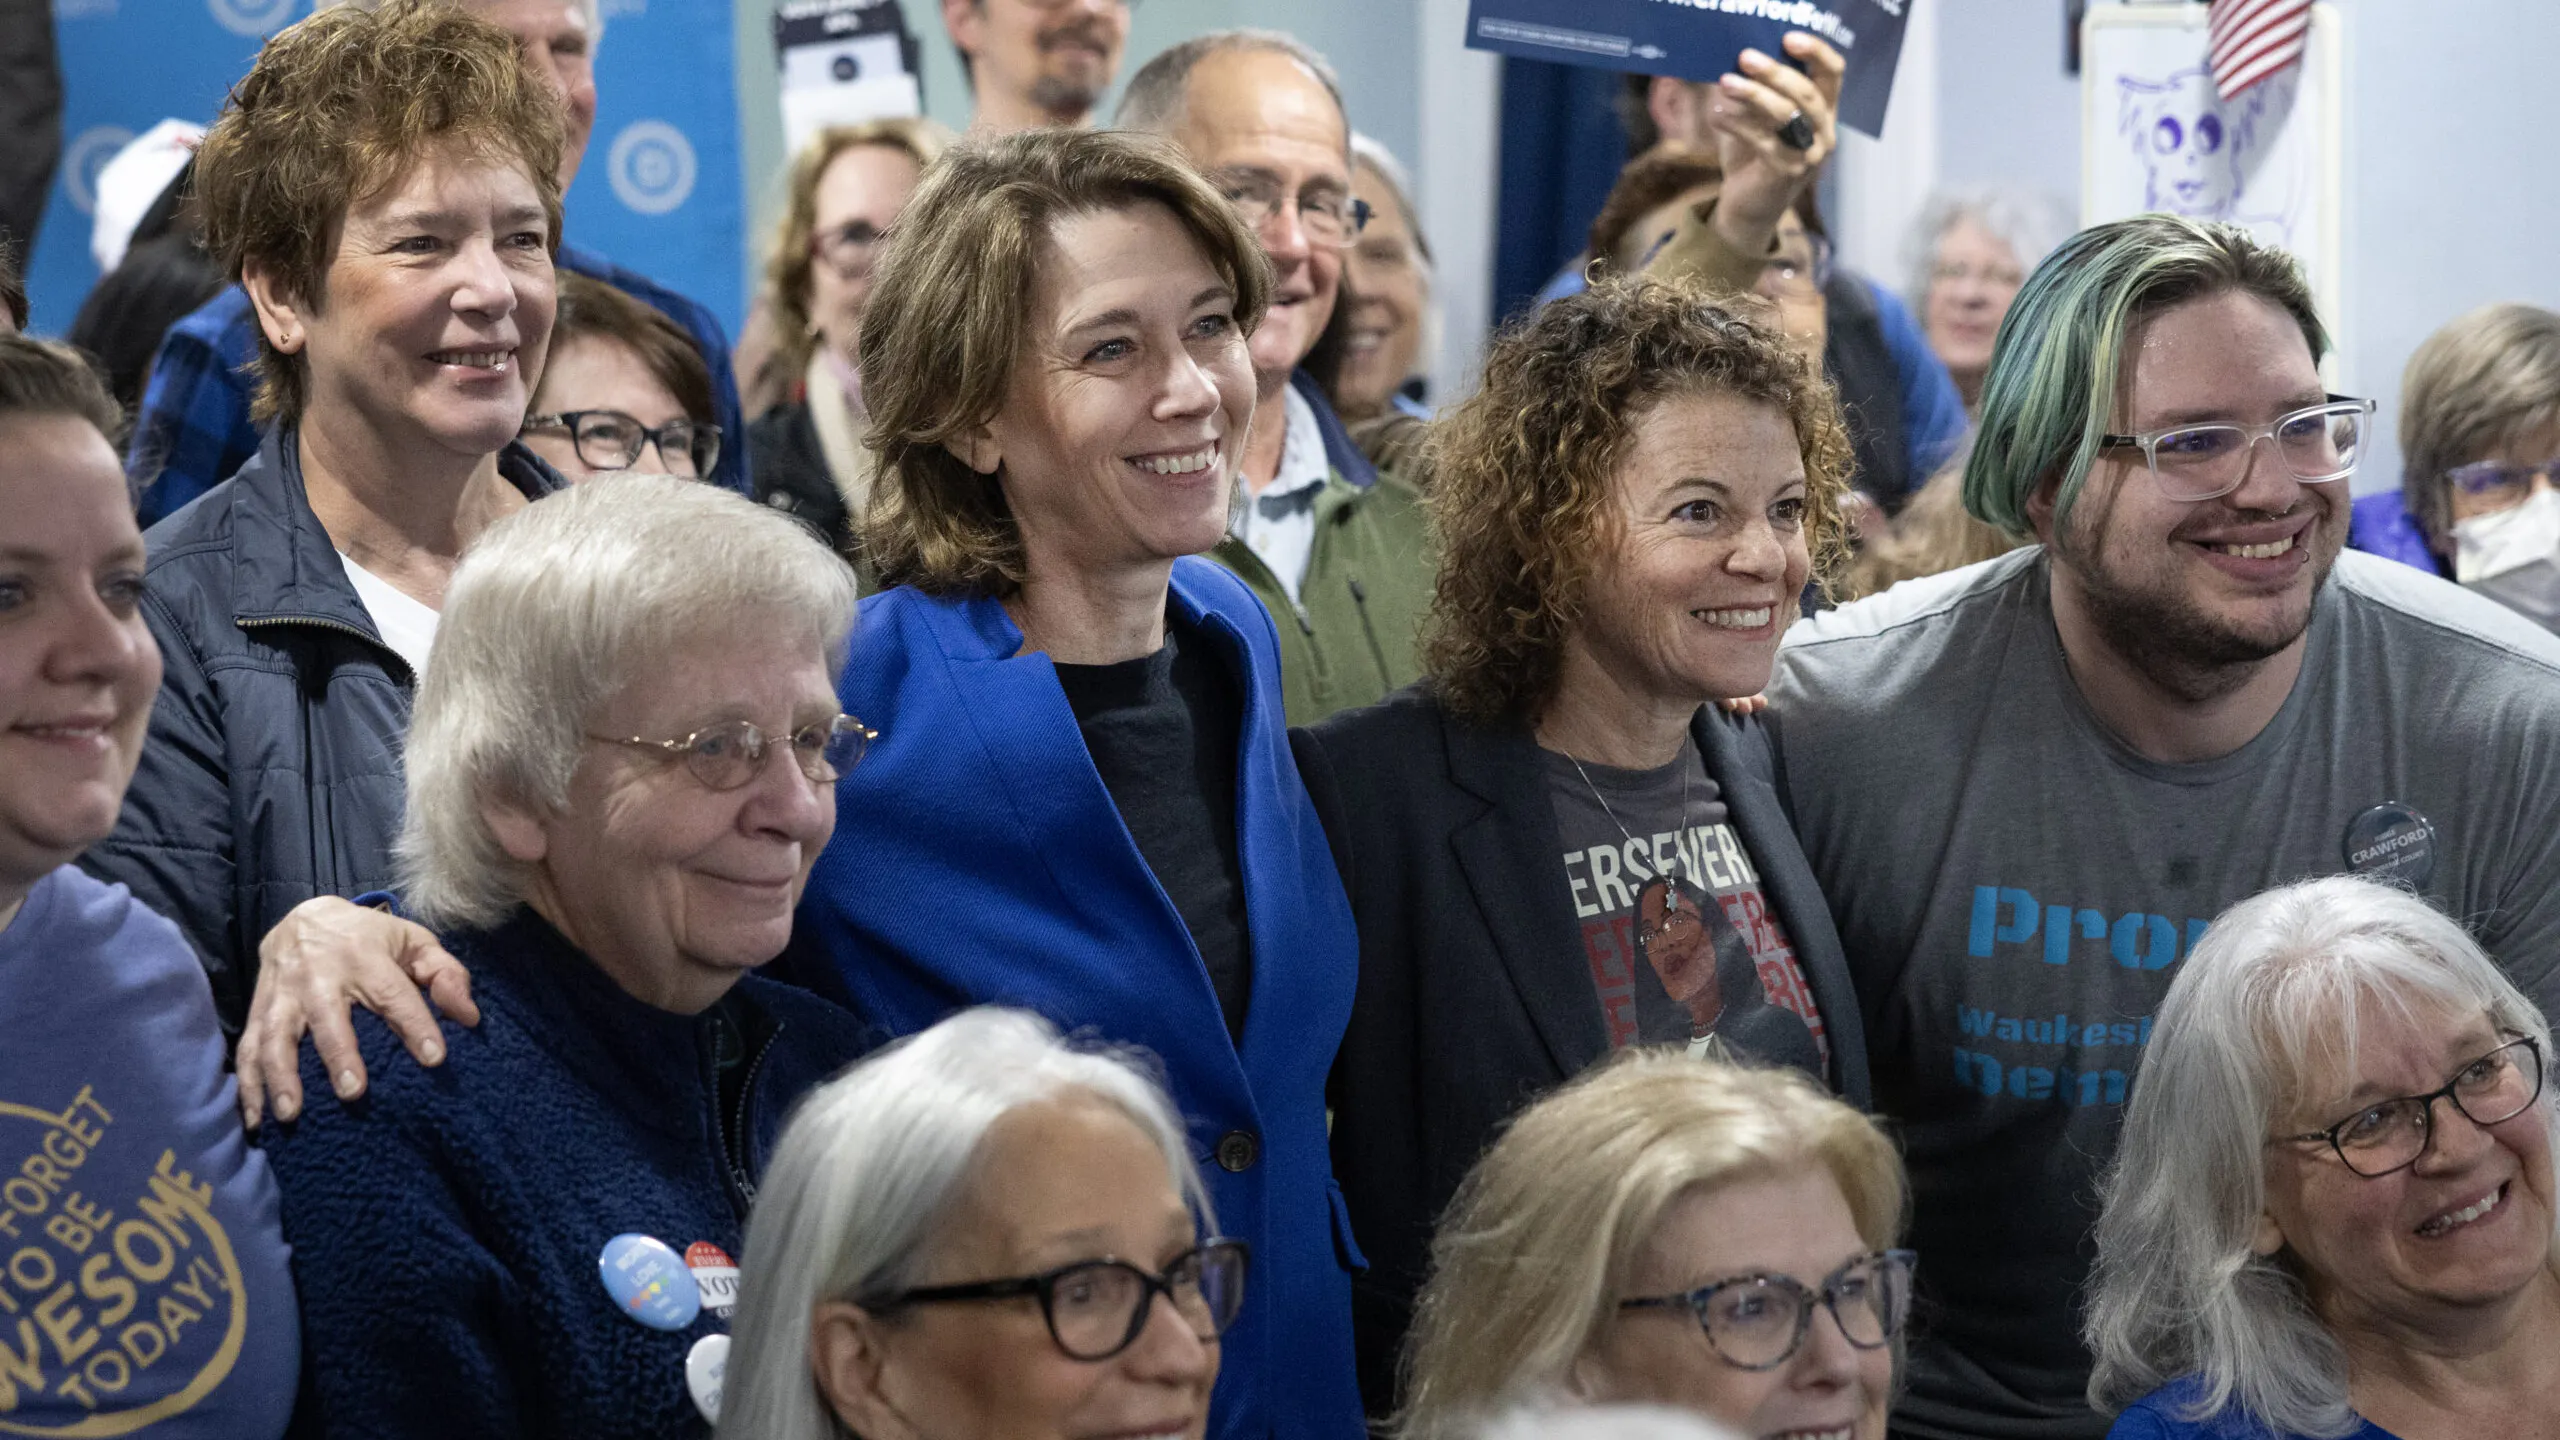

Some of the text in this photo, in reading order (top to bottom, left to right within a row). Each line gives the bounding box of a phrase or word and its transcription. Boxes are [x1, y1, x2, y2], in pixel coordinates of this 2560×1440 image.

[1563, 823, 1759, 918] ERSEVER
[2351, 827, 2428, 865] CRAWFORD
[45, 1191, 114, 1254] BE
[56, 1256, 230, 1408] TODAY!
